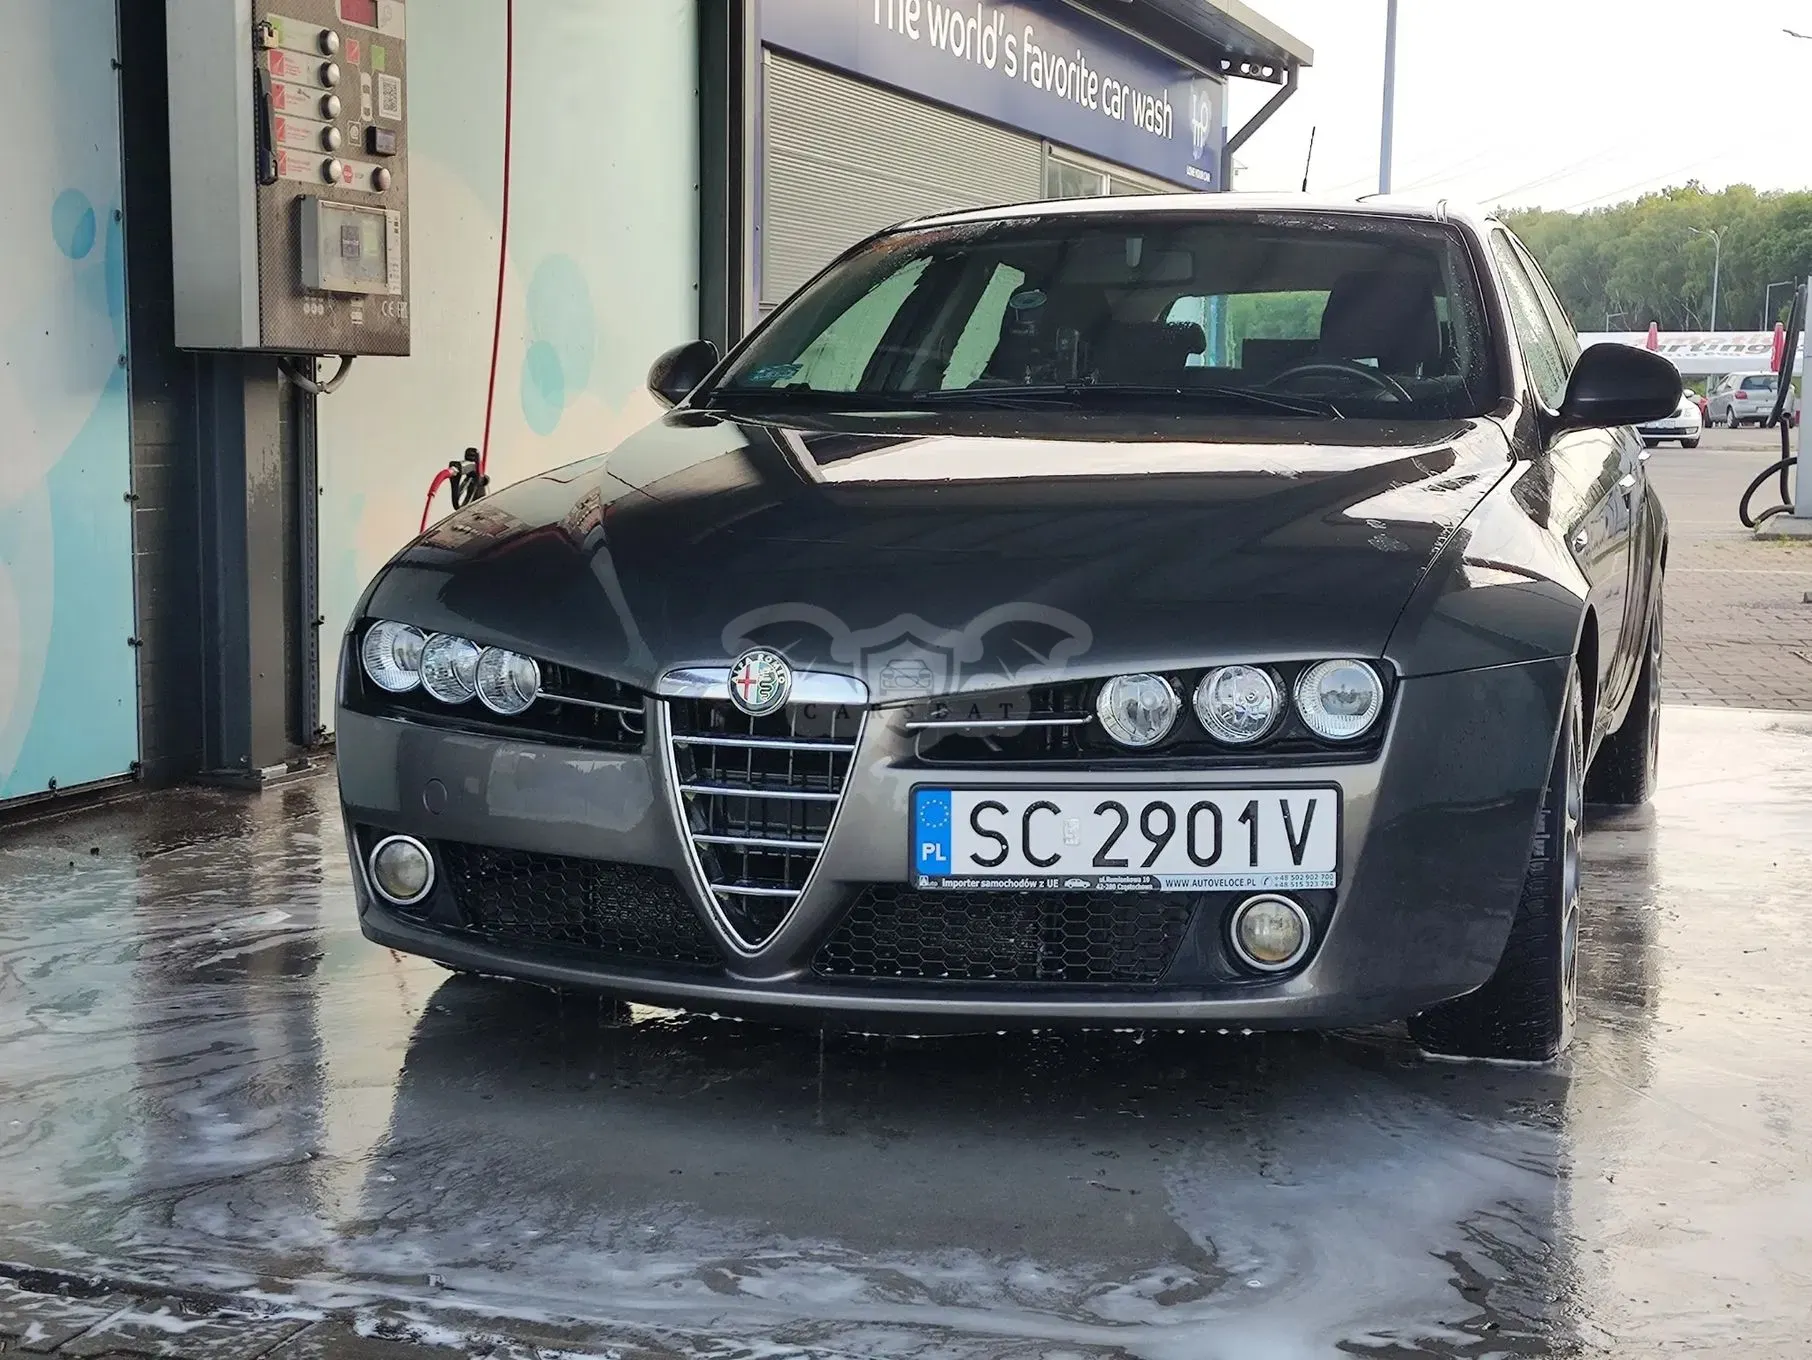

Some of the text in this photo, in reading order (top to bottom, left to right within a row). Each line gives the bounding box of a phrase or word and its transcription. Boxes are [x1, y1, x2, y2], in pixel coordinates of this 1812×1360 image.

[927, 0, 1018, 79] world's
[1022, 24, 1099, 111] favorite
[1101, 76, 1130, 122] car
[1132, 88, 1174, 140] wash
[921, 842, 947, 861] PL
[969, 800, 1062, 868] SC
[1092, 798, 1318, 868] 2901V
[941, 877, 1059, 889] Importer samochodów z UE
